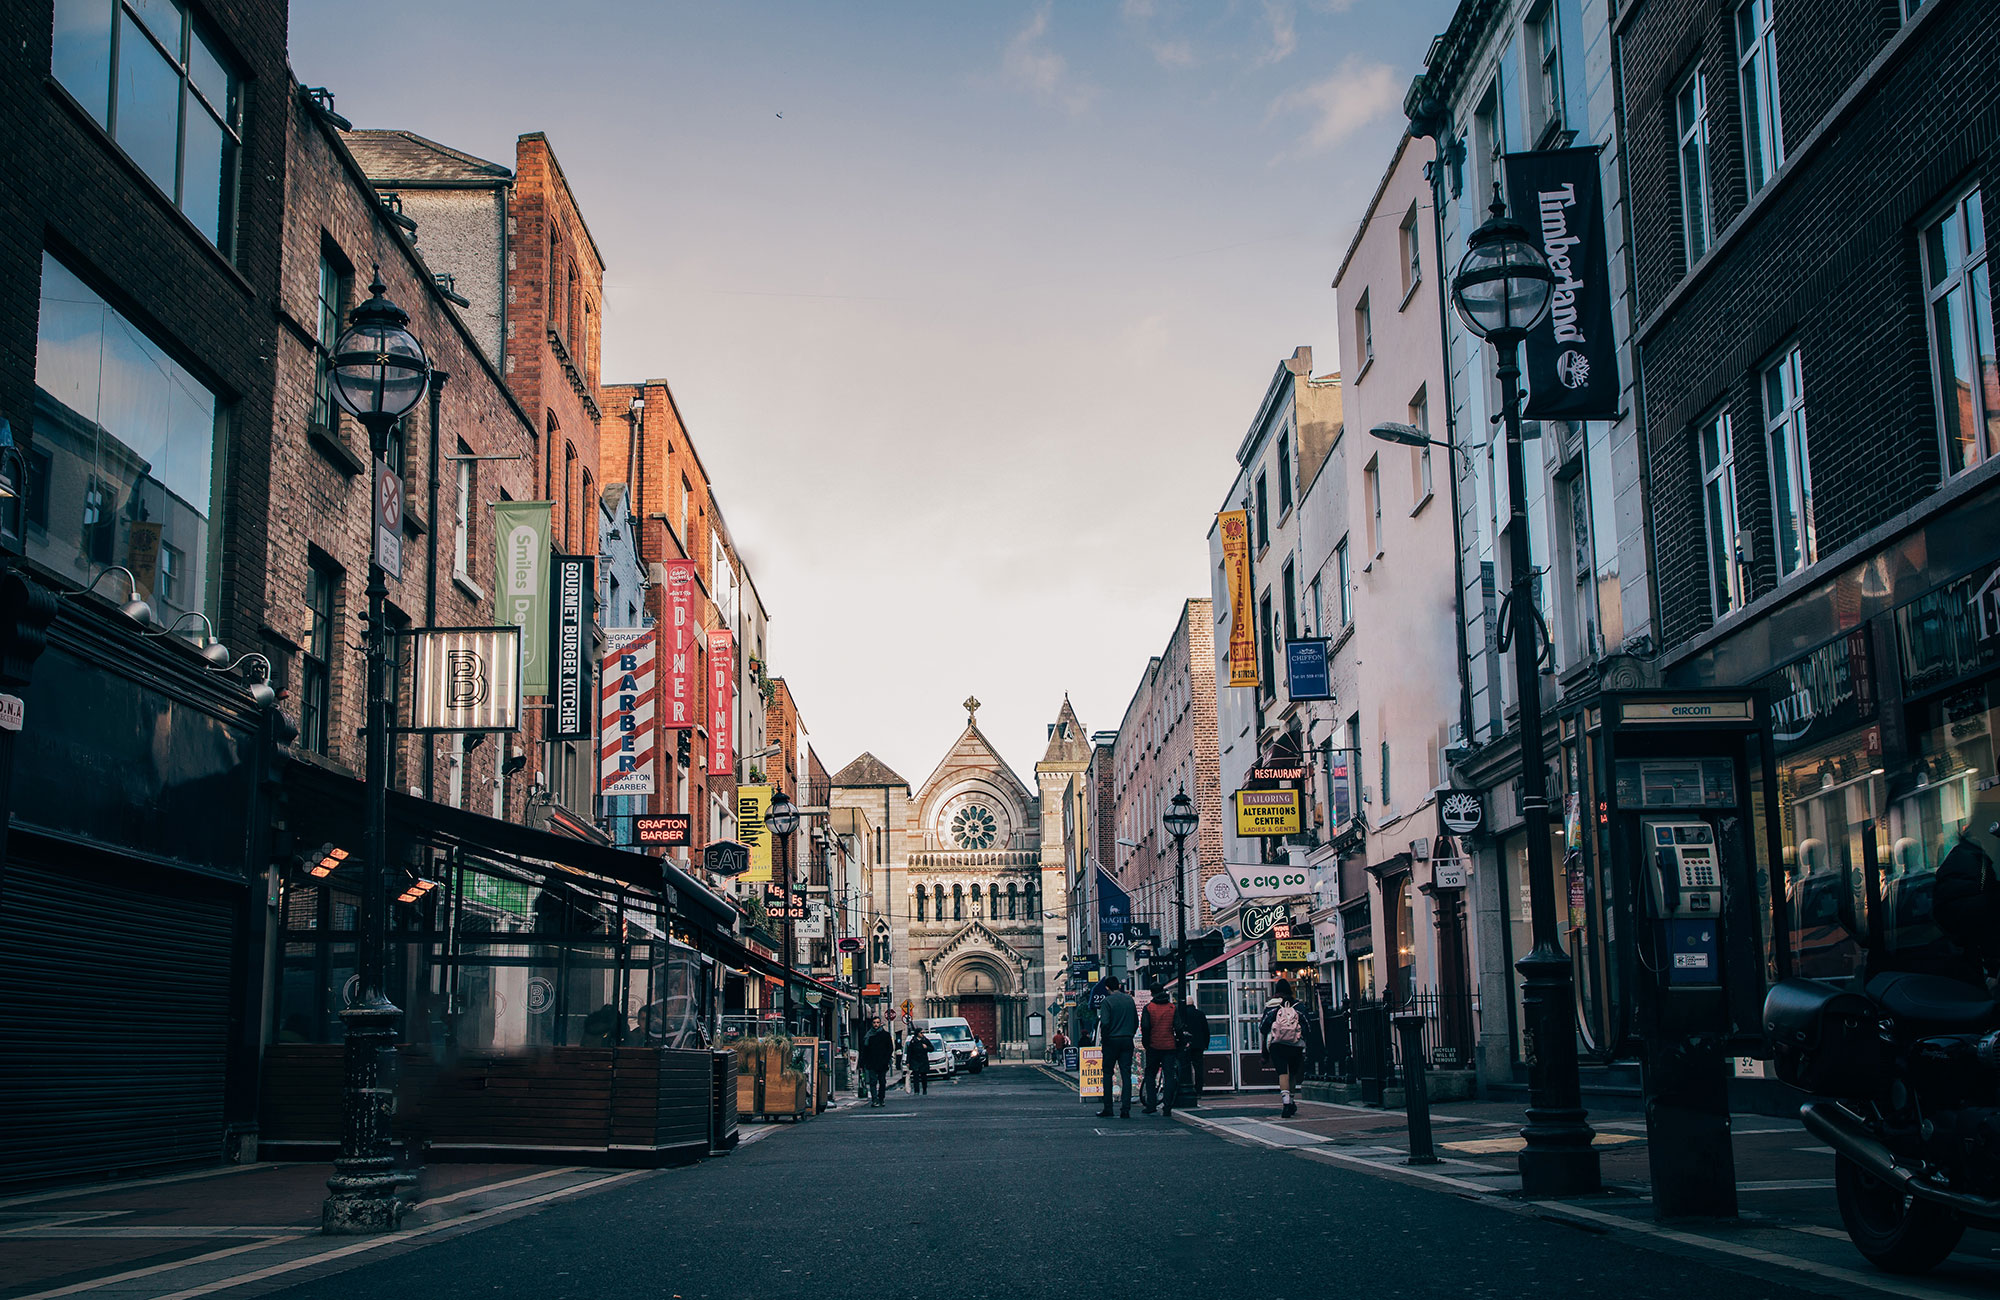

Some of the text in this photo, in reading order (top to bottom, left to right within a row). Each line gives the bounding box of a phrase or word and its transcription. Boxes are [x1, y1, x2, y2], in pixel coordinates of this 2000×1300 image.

[1537, 182, 1586, 344] Timberland
[516, 534, 532, 589] Smiles
[1235, 559, 1245, 638] ALTERATION
[562, 562, 579, 733] GOURMET BURGER KITCHEN
[673, 606, 686, 721] DINER
[1291, 654, 1322, 662] CHIFFON
[447, 650, 486, 708] B
[0, 713, 21, 725] ECURITY
[619, 654, 639, 772] BARBER
[715, 670, 726, 770] DINER
[1254, 769, 1301, 779] RESTAURANT
[1248, 795, 1290, 803] TAILORING
[1243, 807, 1296, 816] ALTERATIONS
[637, 819, 688, 829] GRAFTON
[1254, 816, 1285, 825] CENTRE
[640, 830, 684, 840] BARBER
[707, 848, 746, 870] EAT
[1240, 874, 1305, 889] e cig co
[1109, 932, 1126, 947] 22
[1275, 931, 1290, 939] BAR
[1094, 994, 1105, 1003] 22
